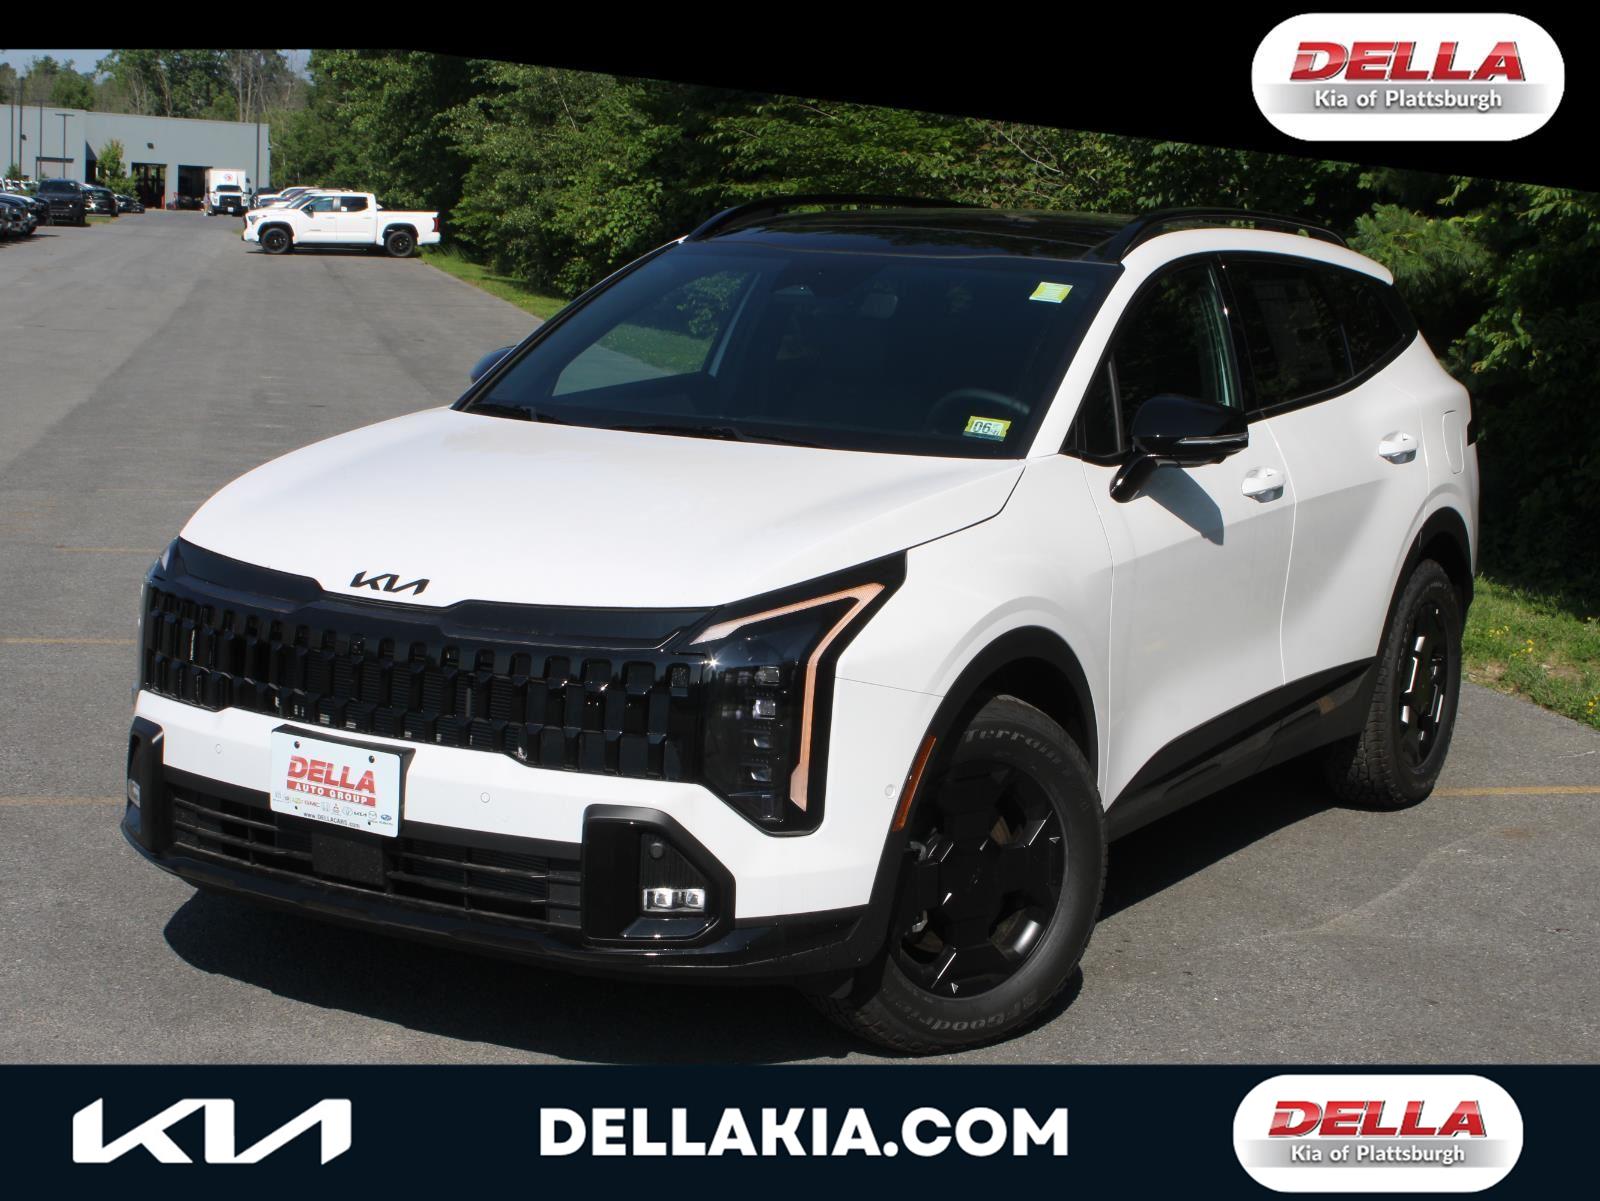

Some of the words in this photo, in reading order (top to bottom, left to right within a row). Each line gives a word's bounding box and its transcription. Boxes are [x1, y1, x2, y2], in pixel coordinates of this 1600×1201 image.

[349, 570, 430, 596] KIA
[288, 755, 376, 793] DELLA
[295, 782, 325, 795] AUTO
[329, 791, 368, 804] GROUP
